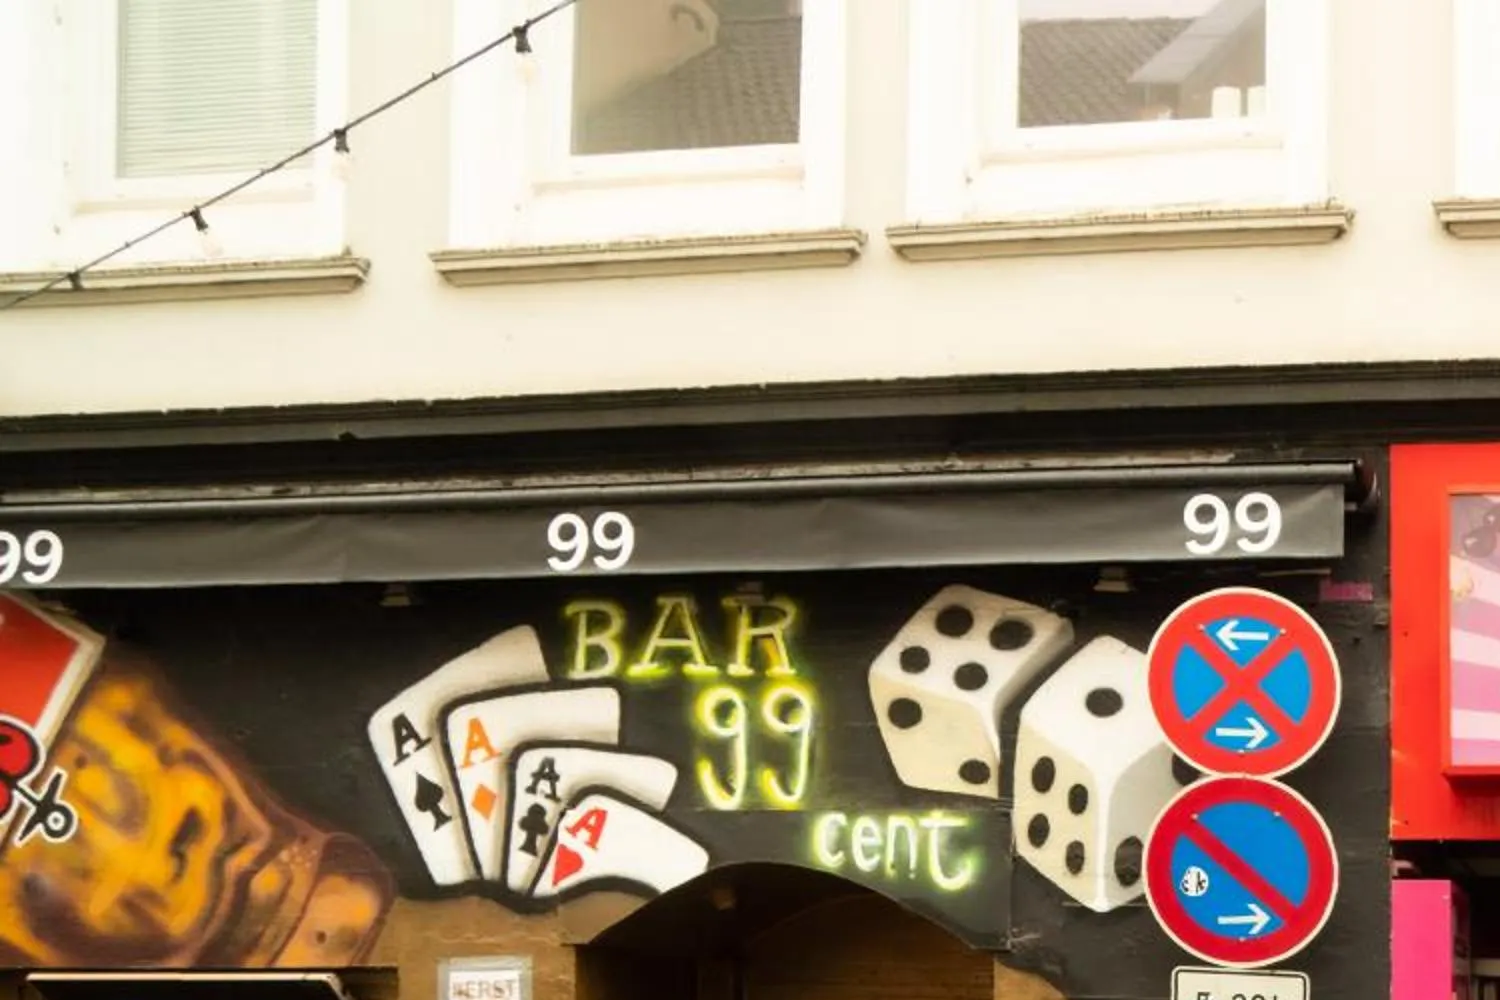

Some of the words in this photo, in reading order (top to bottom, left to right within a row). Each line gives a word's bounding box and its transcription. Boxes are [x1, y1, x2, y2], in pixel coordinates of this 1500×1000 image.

[547, 511, 635, 571] 99
[1183, 491, 1282, 555] 99
[563, 594, 800, 681] BAR
[391, 712, 432, 767] A
[459, 717, 502, 769] A
[697, 683, 815, 811] 99
[525, 756, 562, 803] A
[565, 806, 609, 851] A
[812, 808, 977, 893] cent
